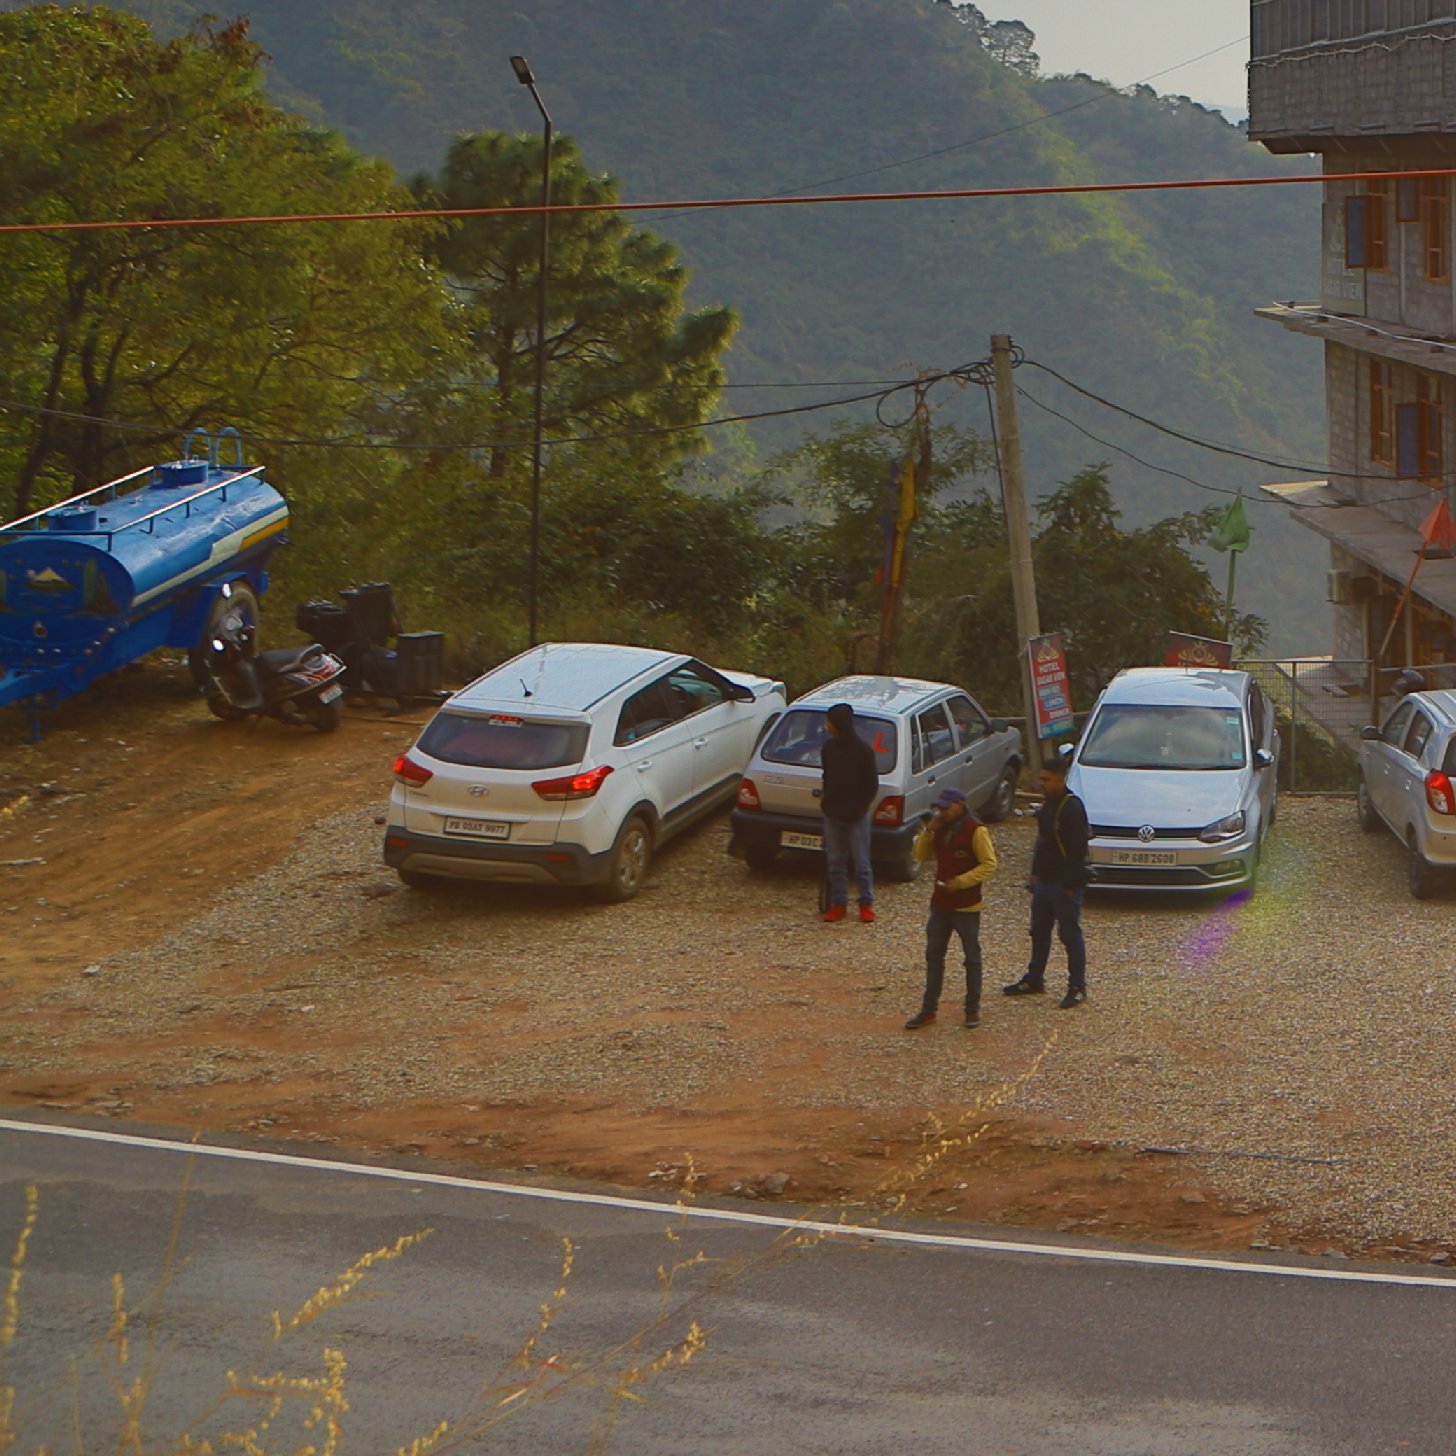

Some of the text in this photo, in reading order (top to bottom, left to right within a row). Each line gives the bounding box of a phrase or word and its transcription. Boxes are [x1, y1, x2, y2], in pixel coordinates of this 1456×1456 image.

[1039, 662, 1060, 673] HOTEL
[450, 820, 461, 830] PB
[1119, 852, 1130, 863] HP
